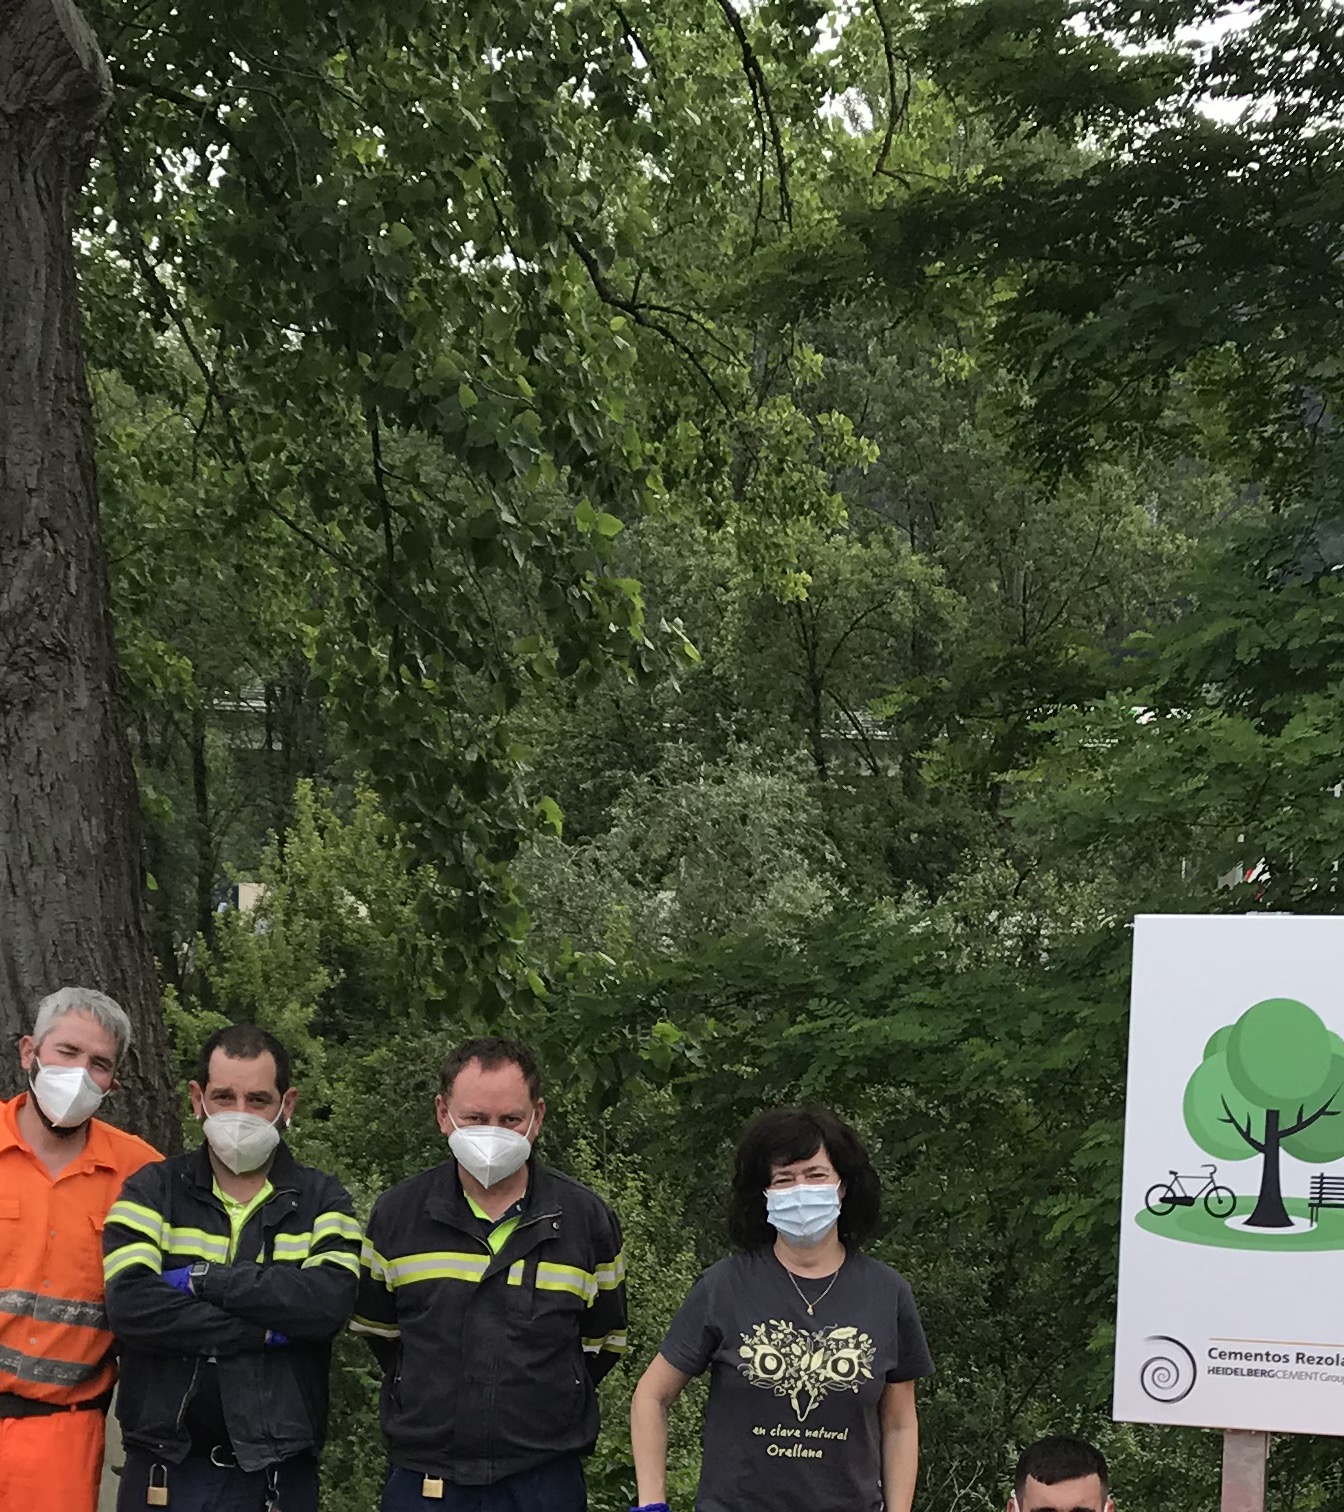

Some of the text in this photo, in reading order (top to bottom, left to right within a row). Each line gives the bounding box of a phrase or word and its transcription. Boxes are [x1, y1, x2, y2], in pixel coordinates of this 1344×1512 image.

[1207, 1347, 1290, 1364] Cementos
[752, 1424, 849, 1441] en clave natural
[766, 1444, 823, 1459] Orellana
